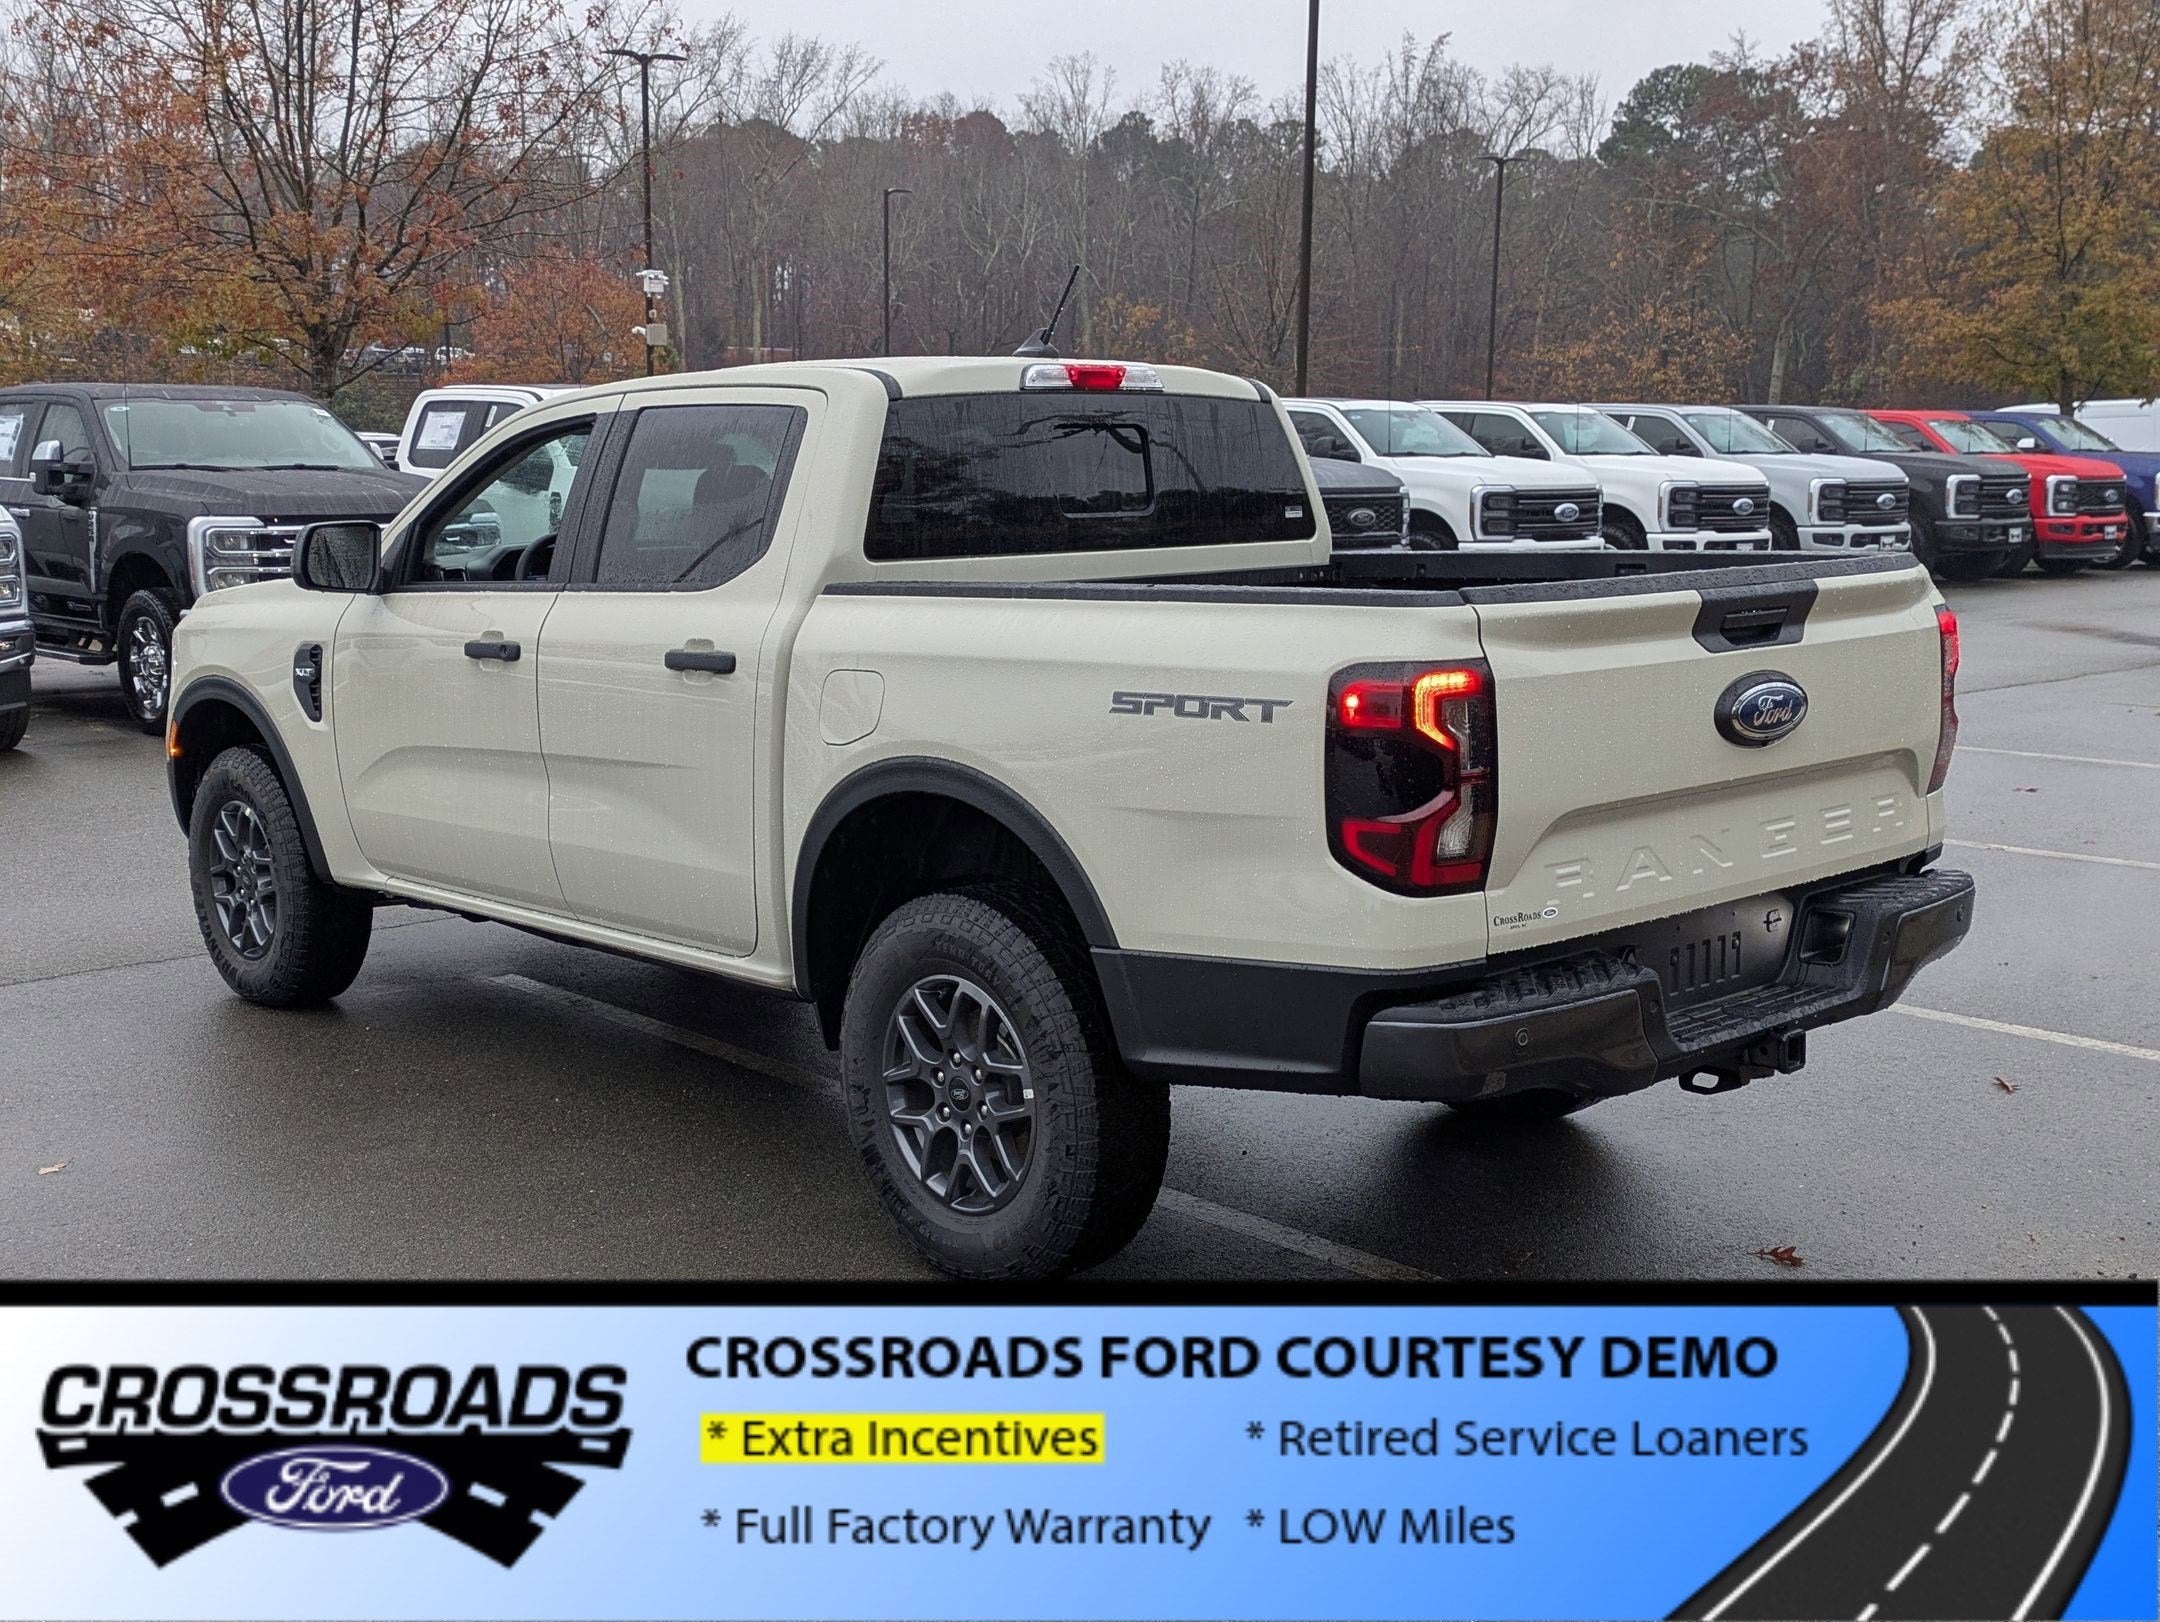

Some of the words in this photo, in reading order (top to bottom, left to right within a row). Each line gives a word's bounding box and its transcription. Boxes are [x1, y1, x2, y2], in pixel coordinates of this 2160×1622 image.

[1109, 691, 1294, 723] SPORT
[1753, 694, 1794, 727] Ford
[1544, 792, 1904, 905] RANGER
